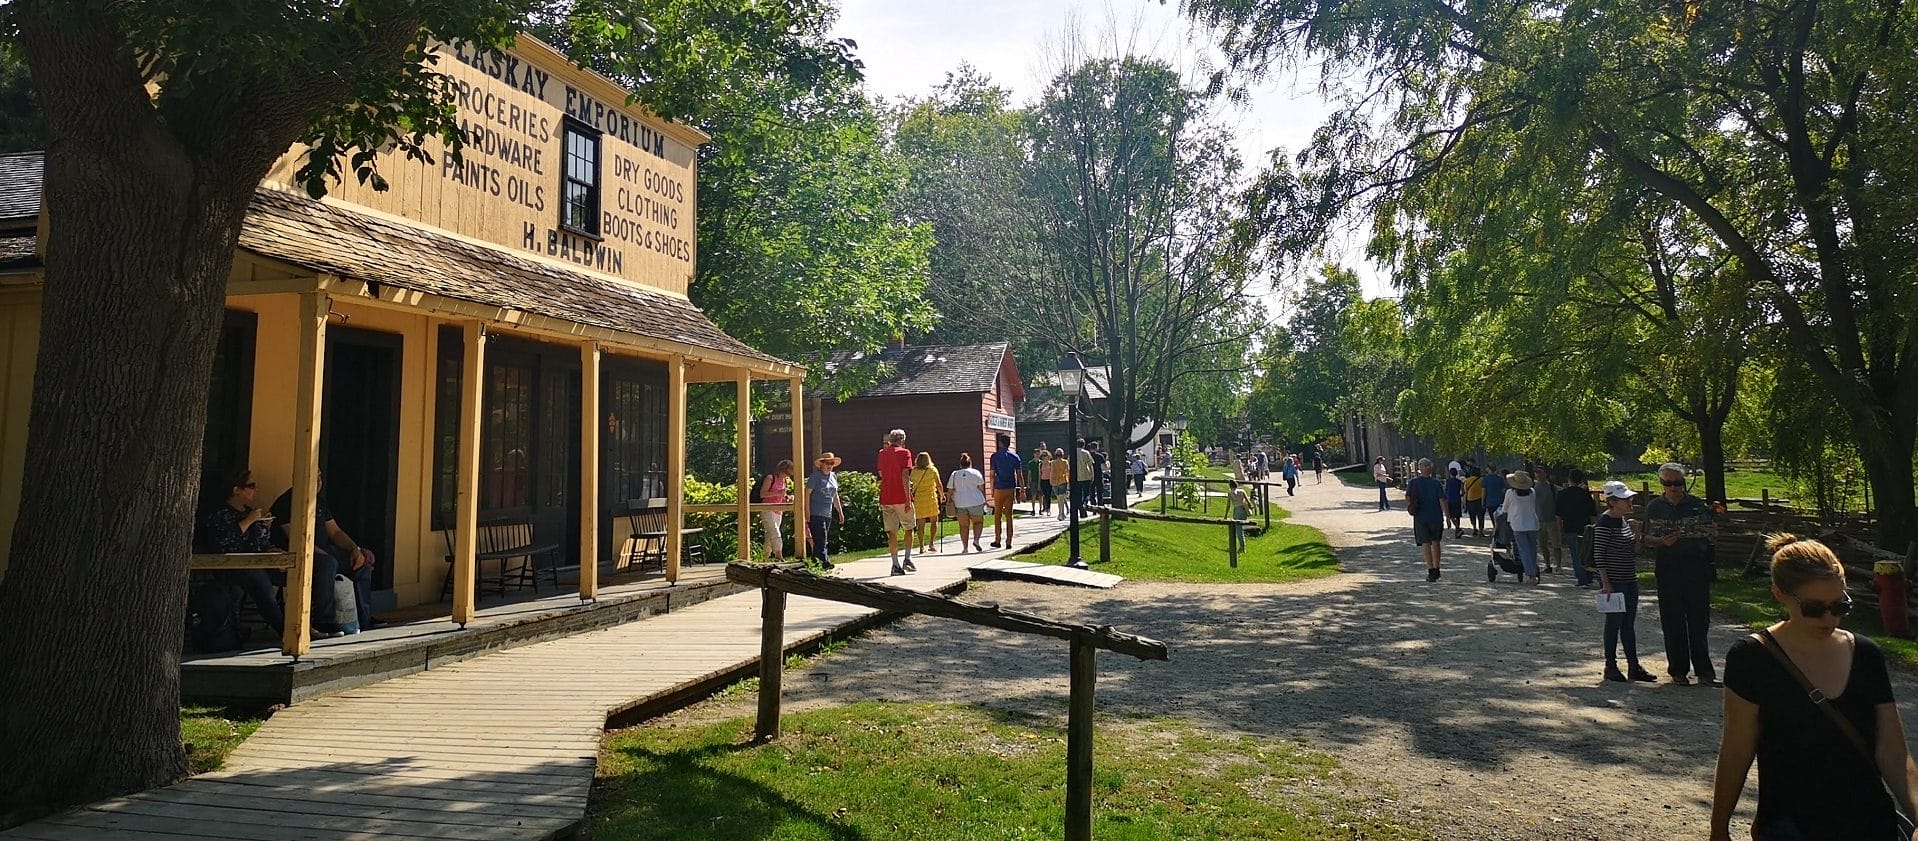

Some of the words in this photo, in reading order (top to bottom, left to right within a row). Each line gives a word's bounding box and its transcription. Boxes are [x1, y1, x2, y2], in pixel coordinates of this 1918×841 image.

[452, 115, 544, 176] ARDWARE
[565, 86, 665, 159] EMPORIUM
[443, 151, 501, 196] PAINTS
[507, 175, 545, 212] OILS
[614, 153, 641, 185] DRY
[644, 167, 684, 204] GOODS
[617, 187, 678, 230] CLOTHING
[523, 221, 541, 251] H.
[547, 229, 623, 275] BALDWIN
